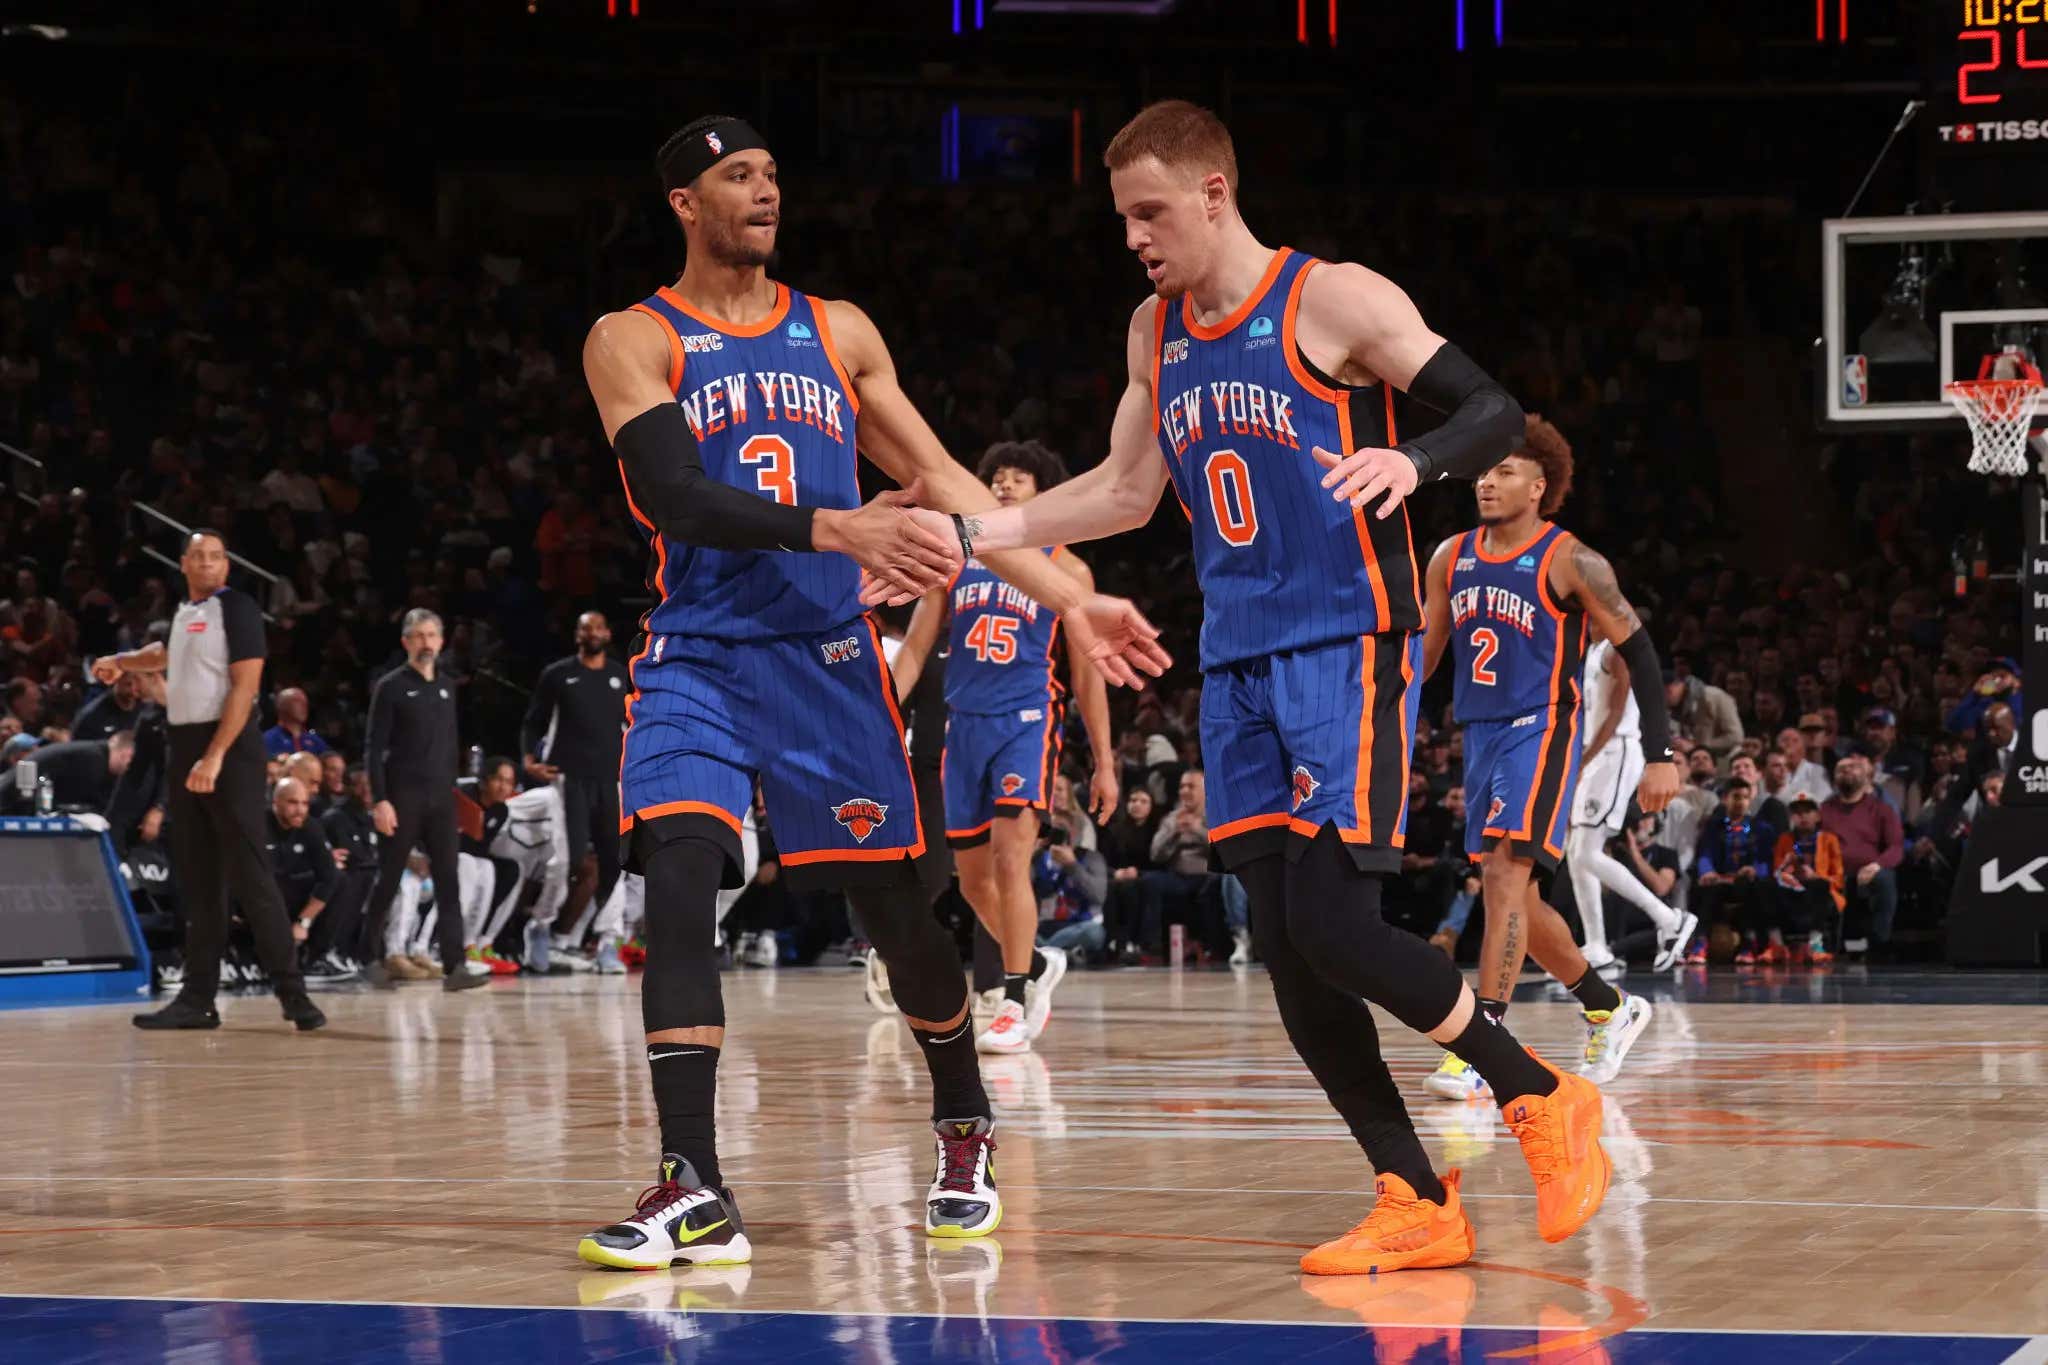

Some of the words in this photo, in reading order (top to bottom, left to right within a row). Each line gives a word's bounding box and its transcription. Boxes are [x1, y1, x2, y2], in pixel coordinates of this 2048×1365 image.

[1245, 336, 1276, 349] sphere
[681, 372, 747, 443] NEW
[756, 372, 844, 444] YORK
[1161, 386, 1202, 464] NEW
[1211, 381, 1300, 450] YORK
[1204, 449, 1259, 547] 0
[955, 581, 993, 615] NEW
[1450, 586, 1480, 629] NEW
[1485, 586, 1536, 639] YORK
[965, 614, 1020, 664] 45
[1471, 627, 1499, 686] 2
[838, 803, 883, 821] KNICKS
